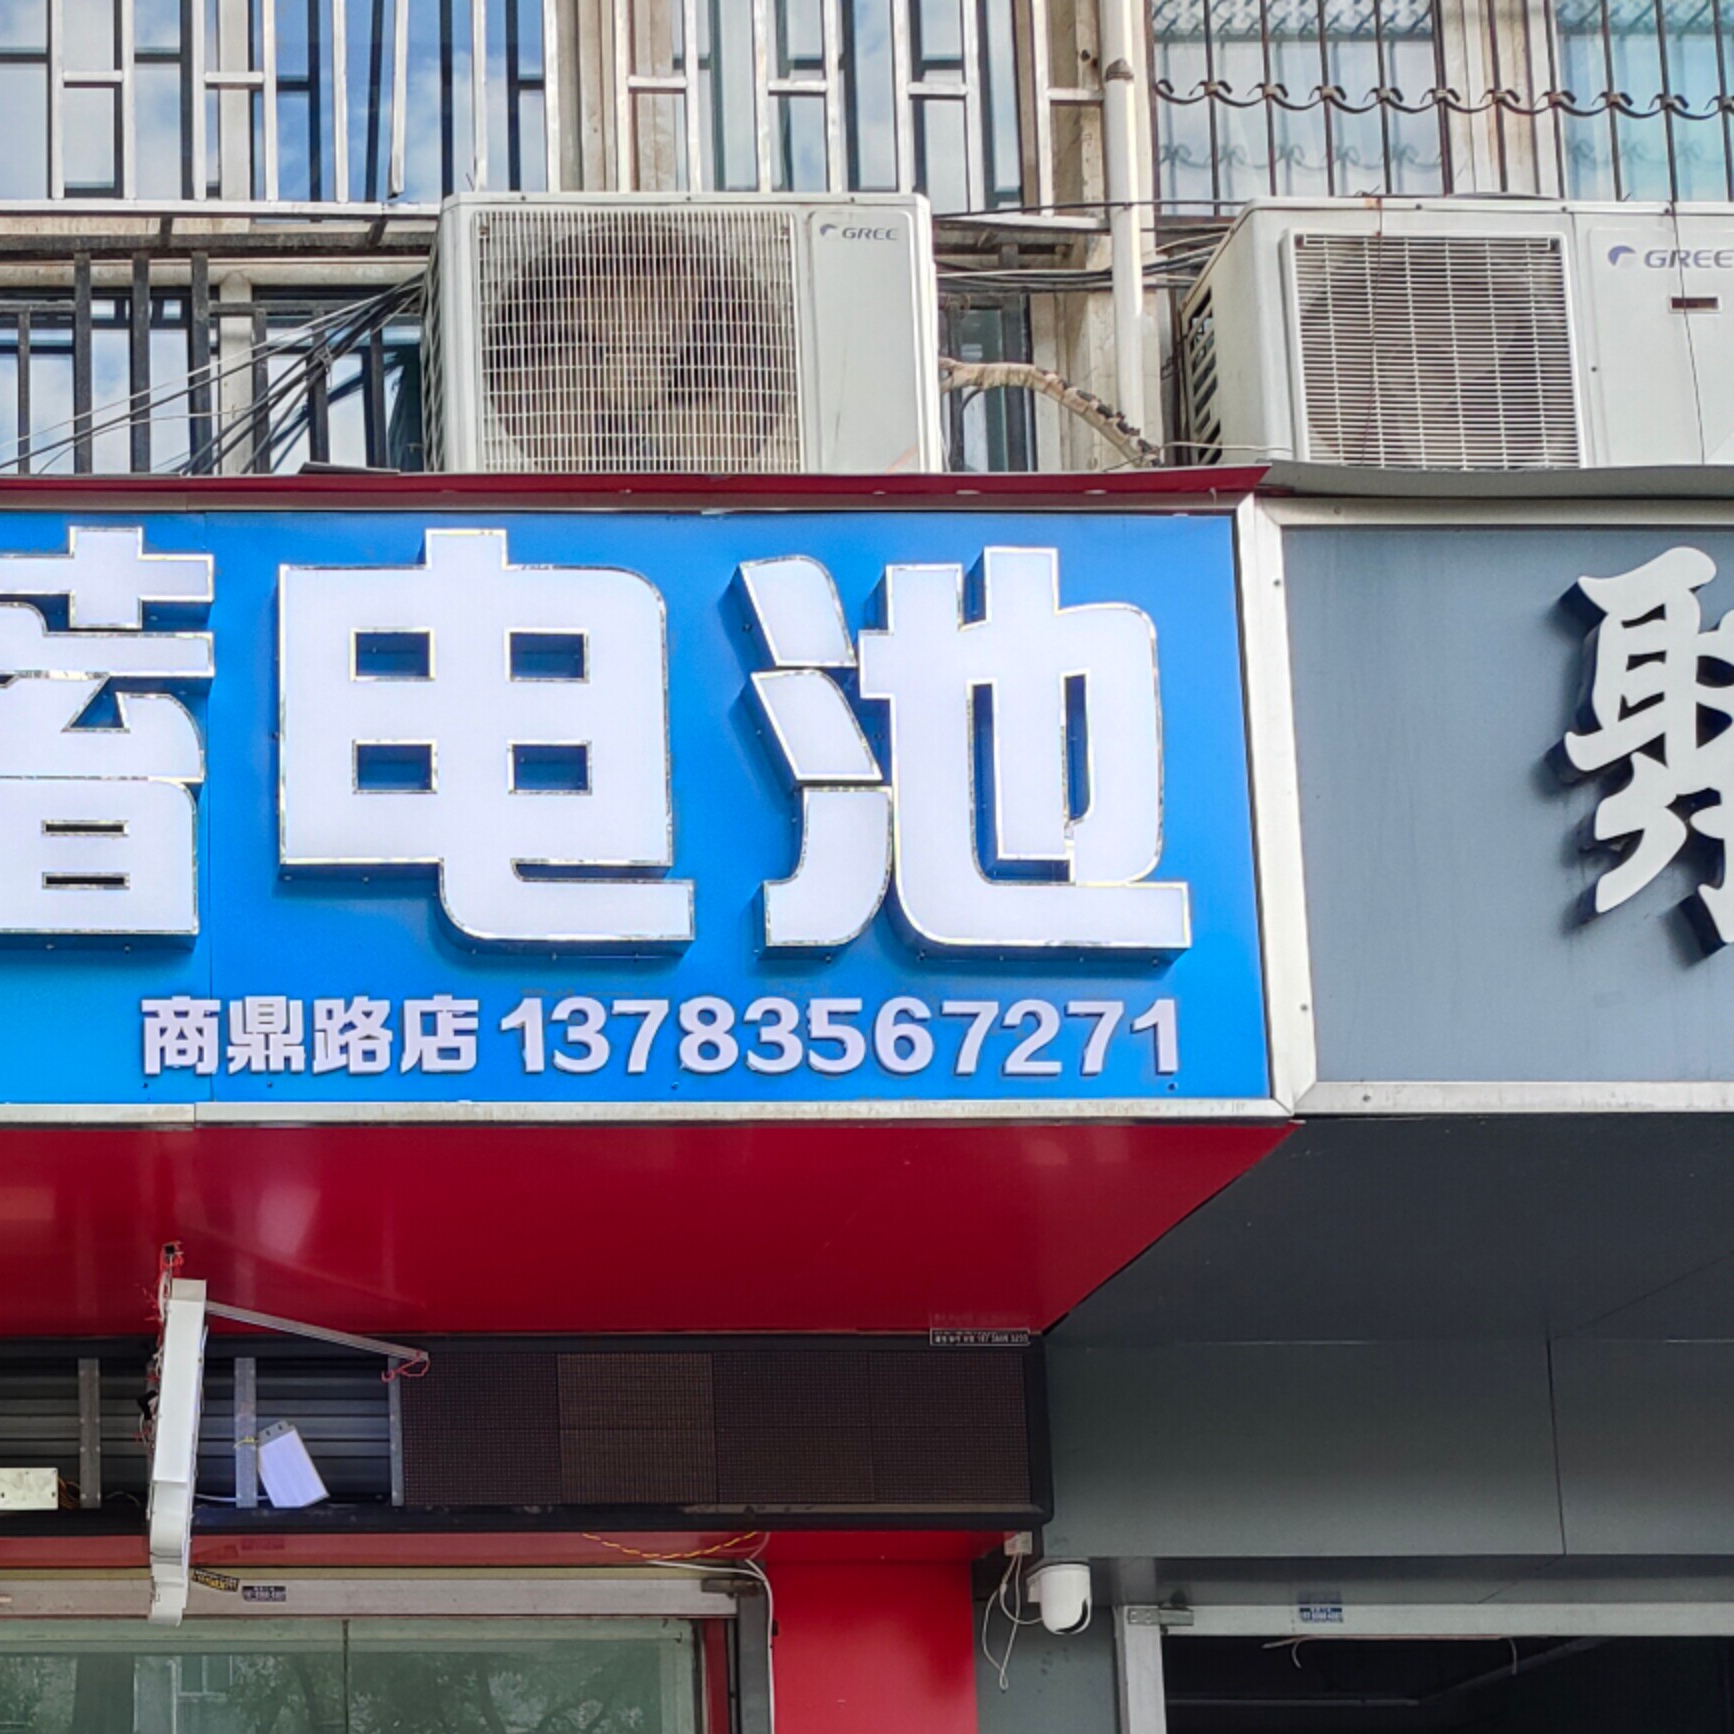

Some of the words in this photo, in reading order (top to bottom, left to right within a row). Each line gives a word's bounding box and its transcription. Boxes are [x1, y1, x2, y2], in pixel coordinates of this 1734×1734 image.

[842, 227, 899, 240] GREE
[1644, 249, 1734, 269] GREE
[141, 994, 479, 1076] 商鼎路店
[500, 996, 1181, 1076] 13783567271
